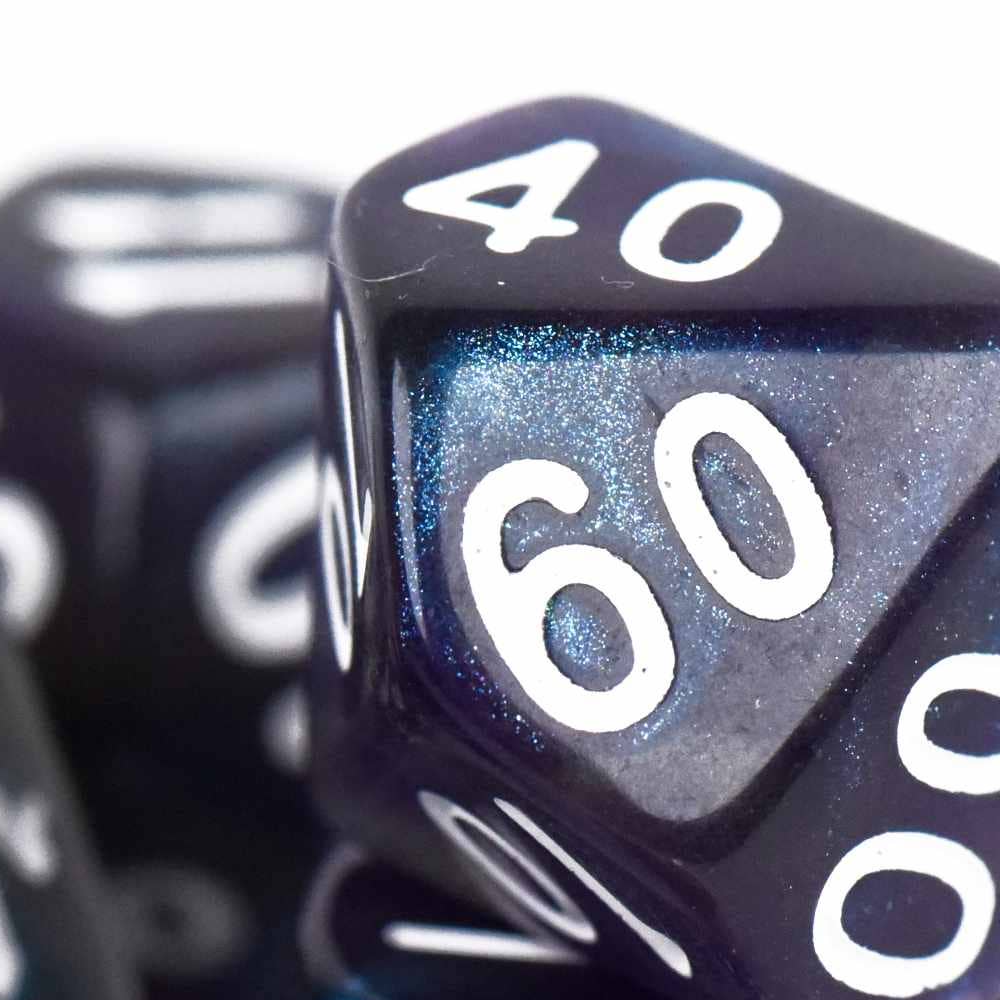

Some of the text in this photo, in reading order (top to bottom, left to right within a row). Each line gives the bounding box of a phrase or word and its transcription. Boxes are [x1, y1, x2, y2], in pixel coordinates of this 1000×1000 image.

[402, 139, 784, 283] 40
[460, 391, 836, 733] 60
[812, 652, 1000, 999] 00
